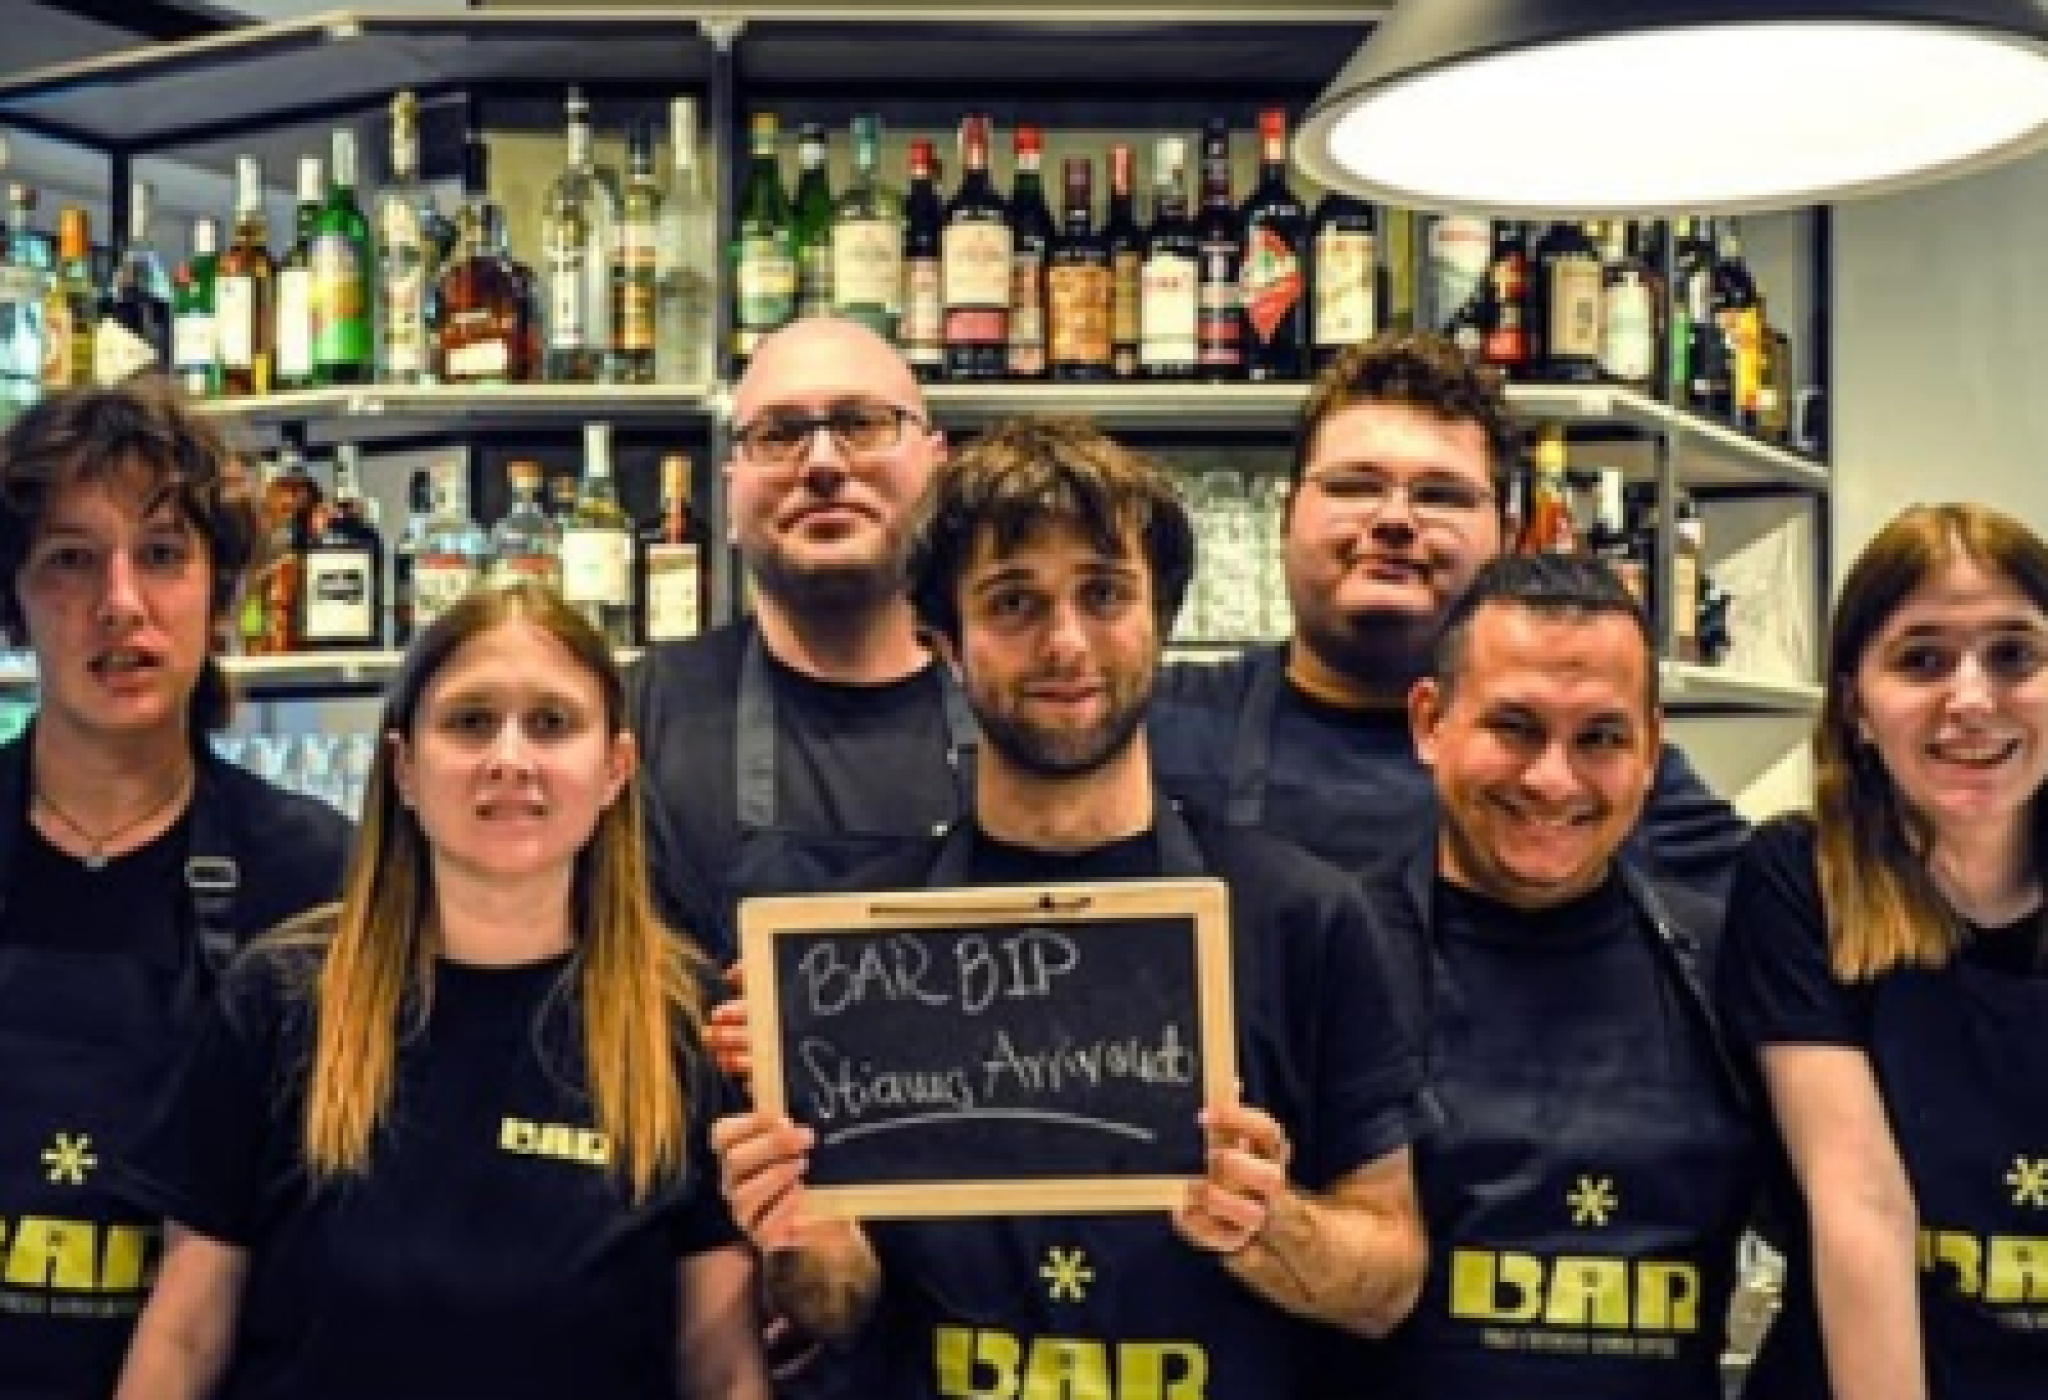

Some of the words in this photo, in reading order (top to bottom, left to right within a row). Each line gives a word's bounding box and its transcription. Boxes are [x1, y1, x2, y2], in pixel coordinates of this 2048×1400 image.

[800, 934, 949, 1016] BAR
[953, 928, 1081, 1016] BIP
[1449, 1246, 1701, 1334] BAR
[932, 1322, 1209, 1400] BAR
